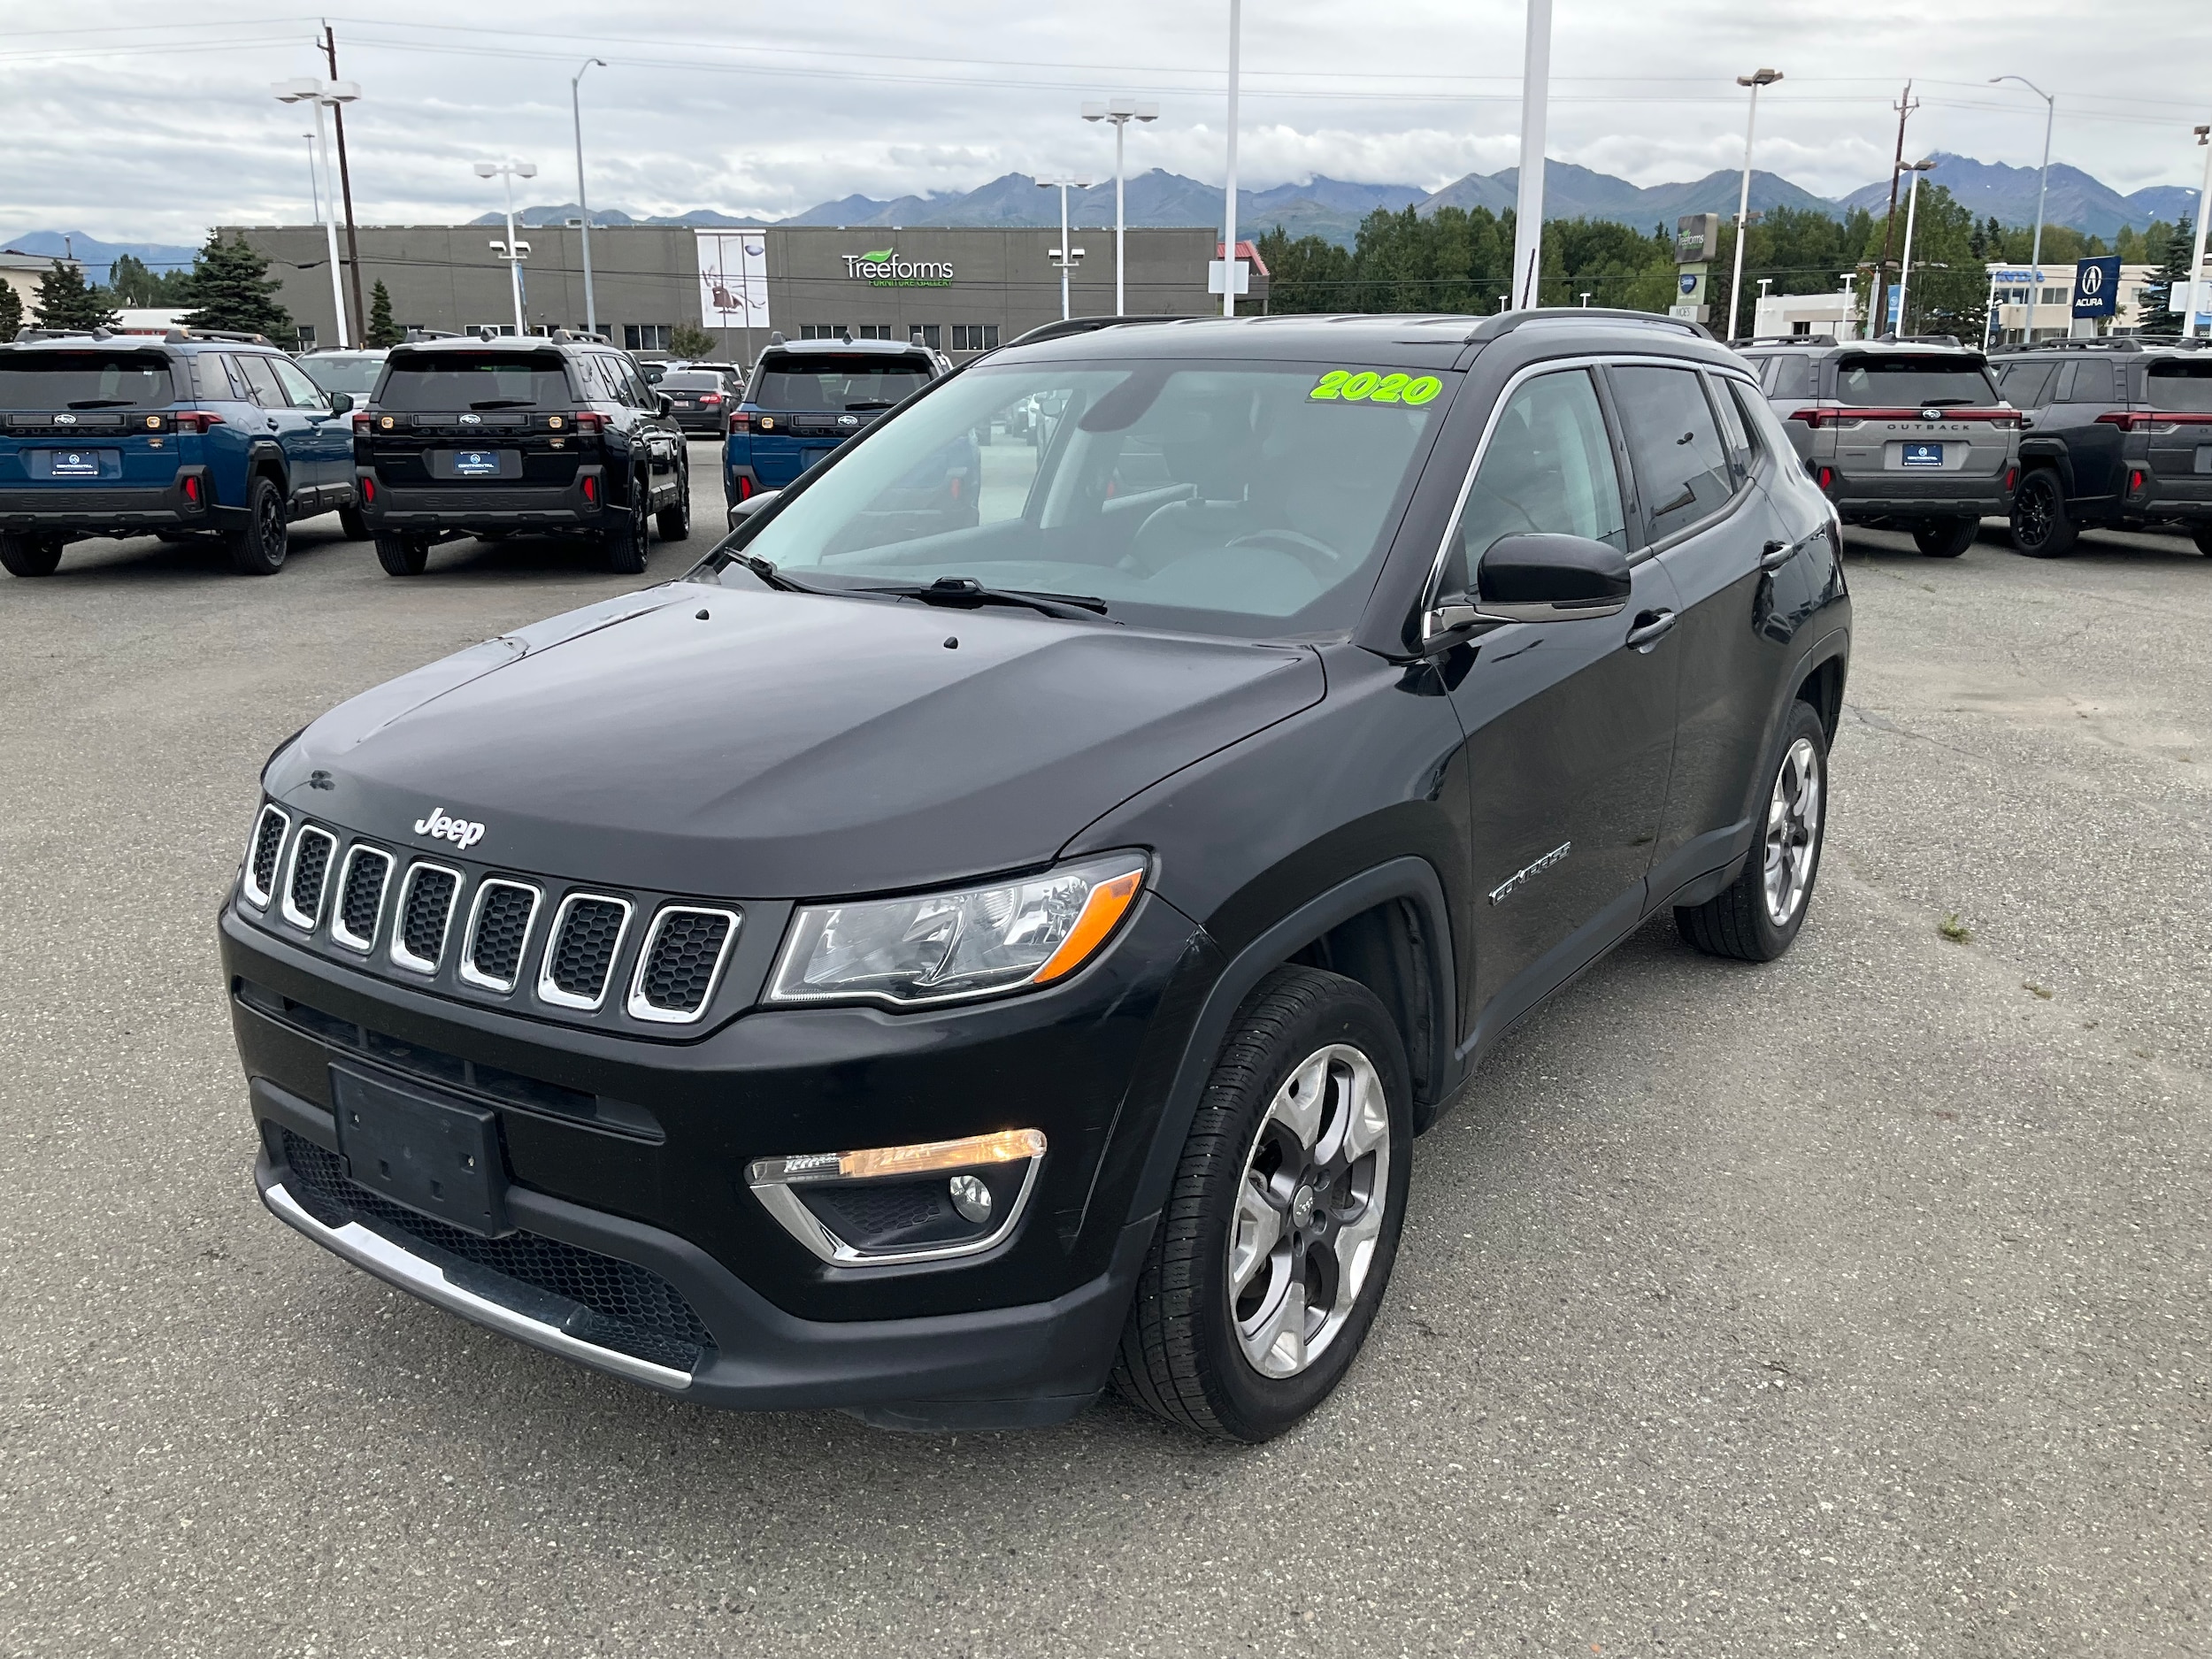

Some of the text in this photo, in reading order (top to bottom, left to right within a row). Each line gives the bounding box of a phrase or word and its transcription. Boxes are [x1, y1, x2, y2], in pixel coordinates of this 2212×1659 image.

[841, 253, 954, 279] Treeforms
[2075, 297, 2103, 307] ACURA
[1310, 370, 1443, 405] 2020
[414, 806, 486, 850] Jeep
